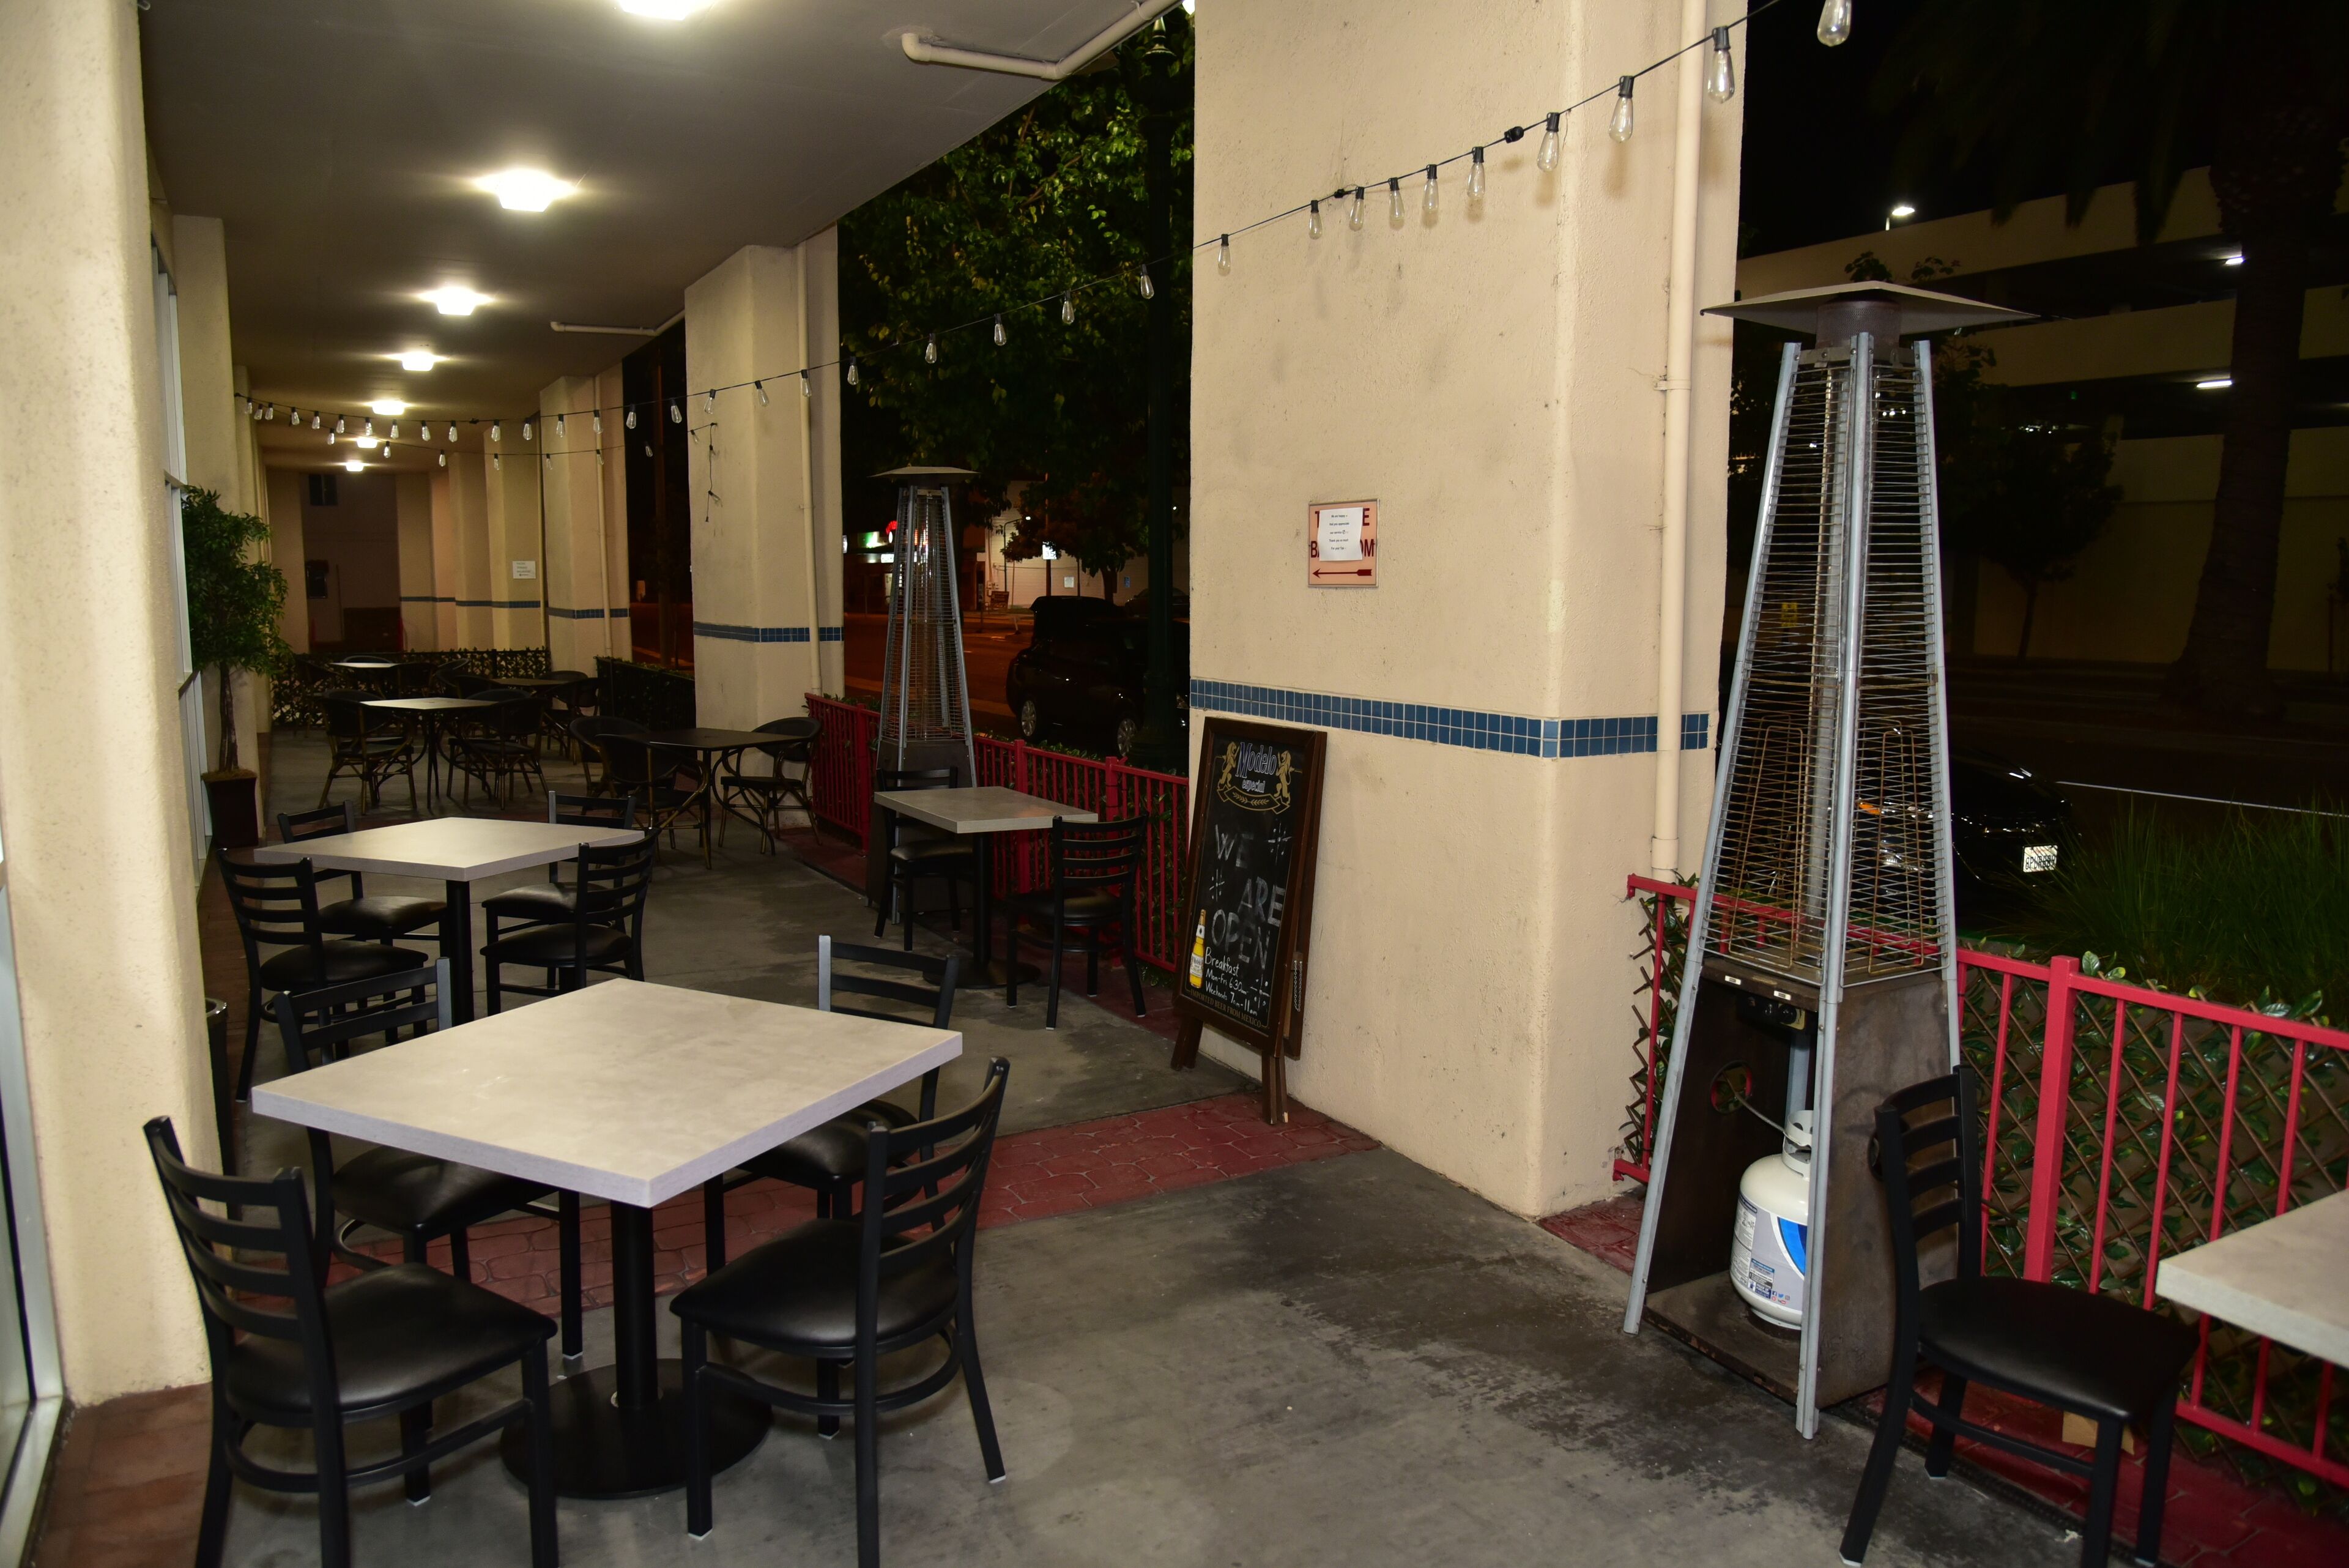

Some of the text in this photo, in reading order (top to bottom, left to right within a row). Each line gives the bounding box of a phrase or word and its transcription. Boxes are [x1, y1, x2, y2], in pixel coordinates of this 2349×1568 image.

[1234, 741, 1277, 779] Modelo
[1215, 824, 1254, 868] WE
[1238, 875, 1285, 927] ARE
[1211, 909, 1271, 970] OPEN
[1204, 946, 1240, 977] Breakfast
[1206, 968, 1227, 986] Mon-Fri
[1190, 989, 1261, 1028] IMPORTED BEER FROM MEXICO
[1205, 980, 1228, 1000] Weekends
